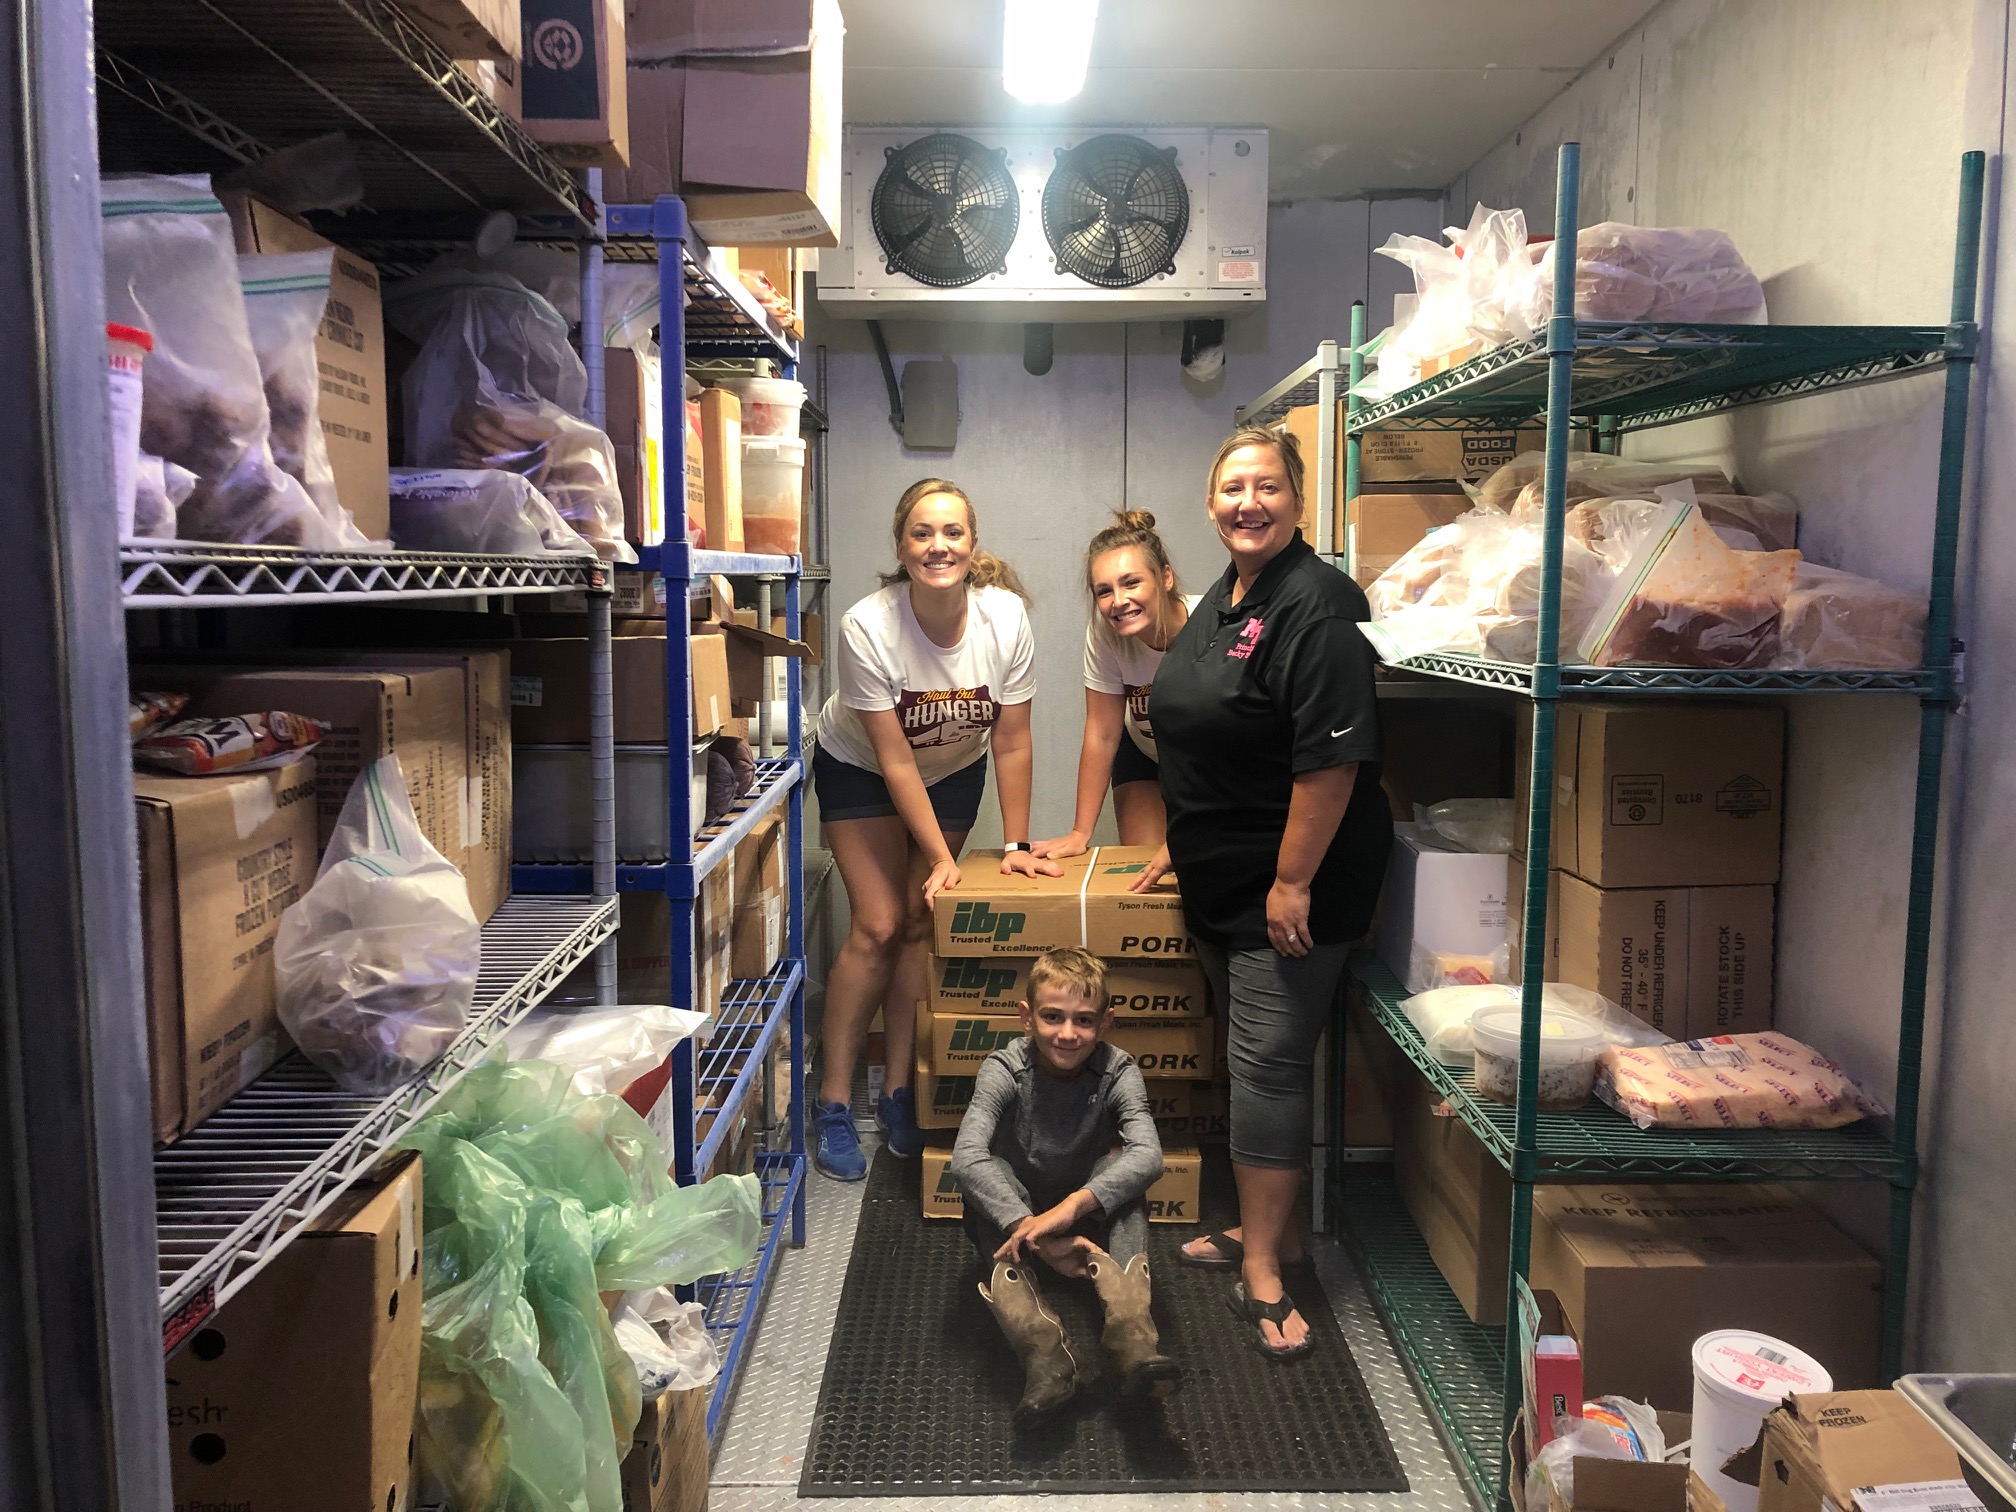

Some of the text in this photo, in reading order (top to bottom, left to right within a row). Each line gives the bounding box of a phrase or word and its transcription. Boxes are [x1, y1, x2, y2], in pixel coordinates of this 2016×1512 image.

[1467, 439, 1511, 450] FOOD
[1375, 454, 1414, 462] PERISHABLE
[1466, 456, 1512, 466] USDA
[1227, 649, 1246, 659] Becky
[917, 687, 977, 704] Haul Out
[1132, 684, 1151, 697] Ha
[904, 700, 995, 728] HUNGER
[1616, 796, 1657, 805] Corrugated
[1675, 793, 1703, 804] 8170
[1117, 901, 1140, 911] Tyson
[1142, 902, 1165, 910] Fresh
[950, 901, 1027, 942] ibp
[950, 935, 992, 944] Trusted
[1638, 948, 1649, 969] 35°
[1652, 900, 1666, 1032] KEEP UNDER REFRIGER
[941, 958, 1018, 998] ibp
[1621, 937, 1633, 1013] DO NOT FREE
[1717, 925, 1730, 1026] ROTATE STOCK
[1733, 932, 1746, 1019] THIS SIDE UP
[939, 990, 980, 999] Trusted
[981, 1000, 1020, 1009] Excelle
[1109, 994, 1193, 1011] PORK
[1637, 1003, 1648, 1011] F
[1114, 1020, 1137, 1028] Tyson
[1139, 1020, 1162, 1028] Fresh
[946, 1053, 988, 1061] Trusted
[1137, 1054, 1200, 1070] ORK
[1715, 1074, 1750, 1093] SELECT
[1149, 1097, 1178, 1113] RK
[1713, 1098, 1735, 1128] SELEC
[933, 1195, 963, 1203] Trust
[1149, 1200, 1185, 1217] RK
[1562, 1203, 1793, 1218] KEEP REFRIGERATED
[167, 1397, 222, 1426] esh
[1820, 1407, 1852, 1417] KEEP
[1818, 1415, 1867, 1428] FROZEN
